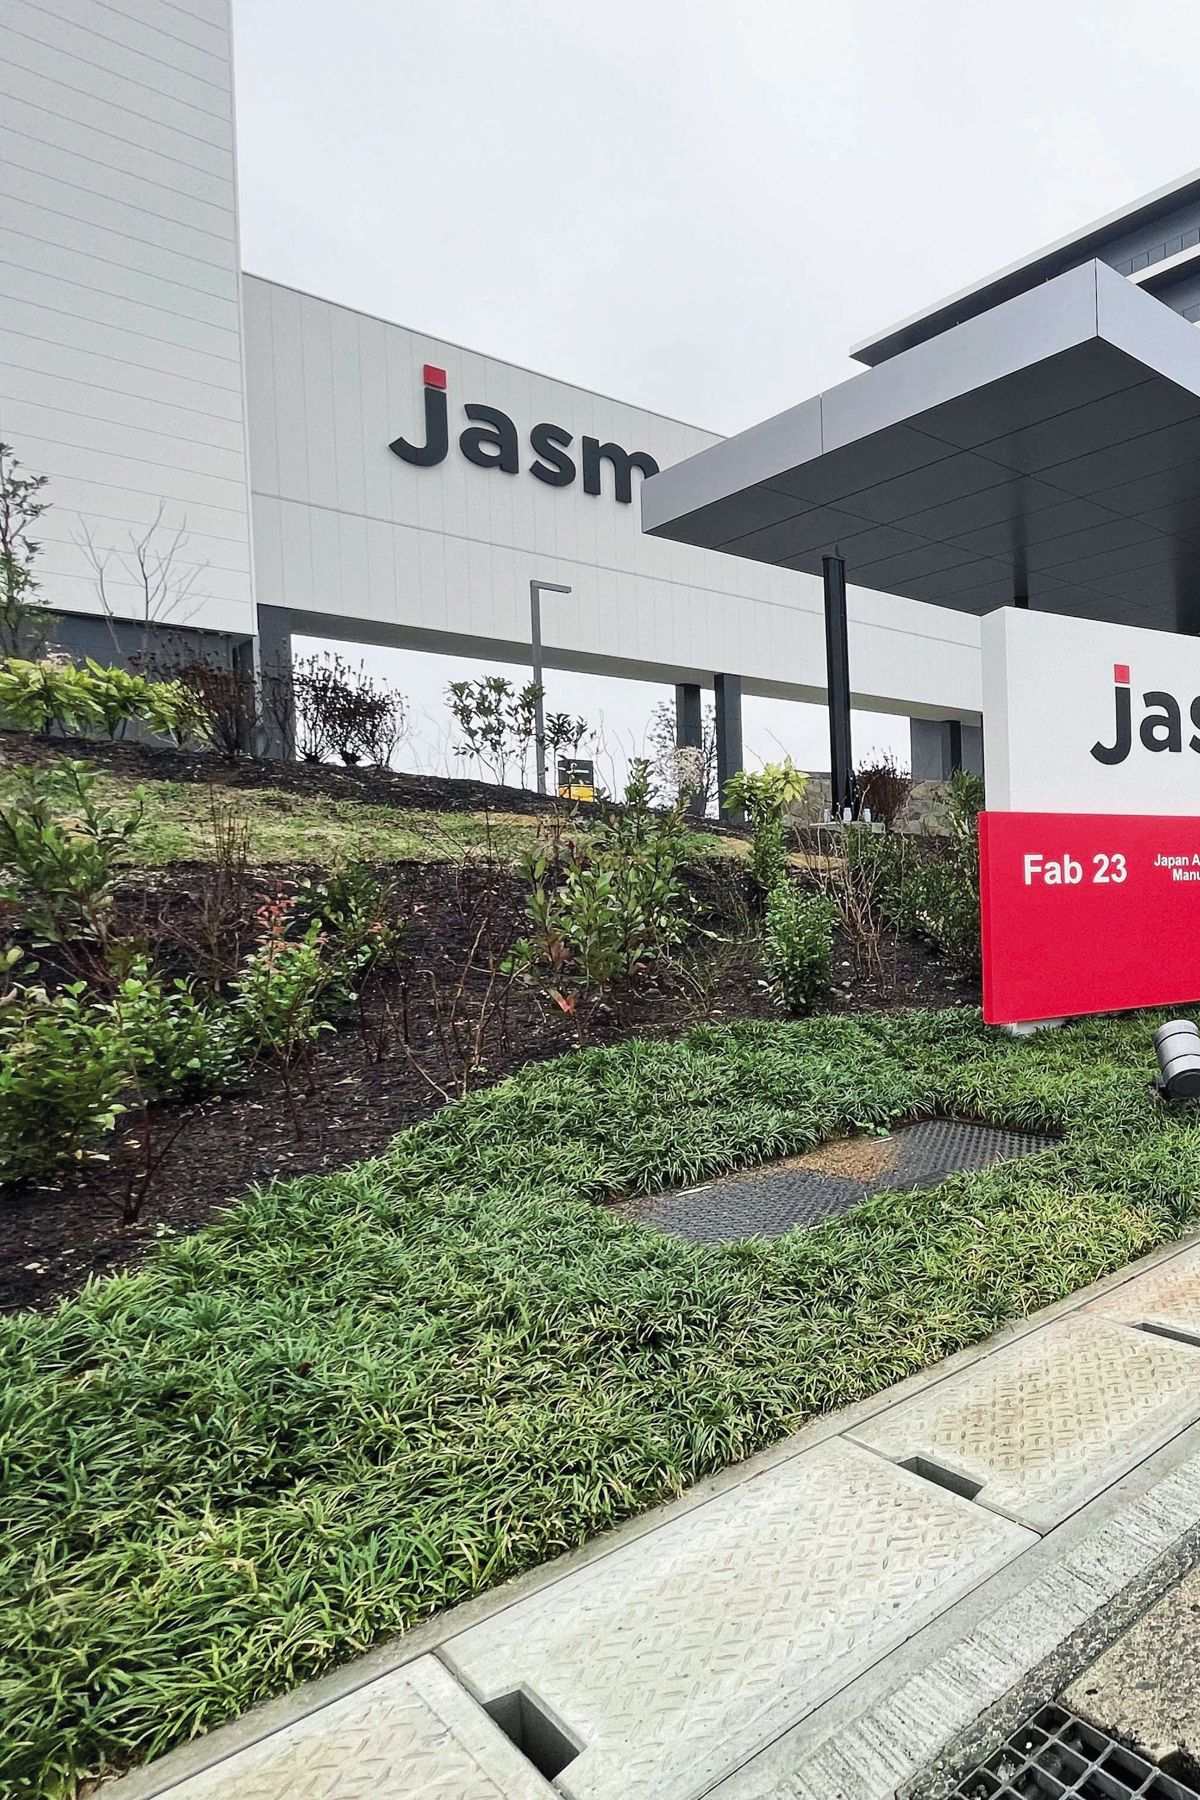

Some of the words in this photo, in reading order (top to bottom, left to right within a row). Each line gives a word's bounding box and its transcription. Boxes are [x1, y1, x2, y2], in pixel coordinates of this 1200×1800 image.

[388, 364, 660, 503] jasm
[1024, 854, 1083, 885] Fab
[1092, 853, 1127, 883] 23
[1154, 853, 1189, 869] Japan
